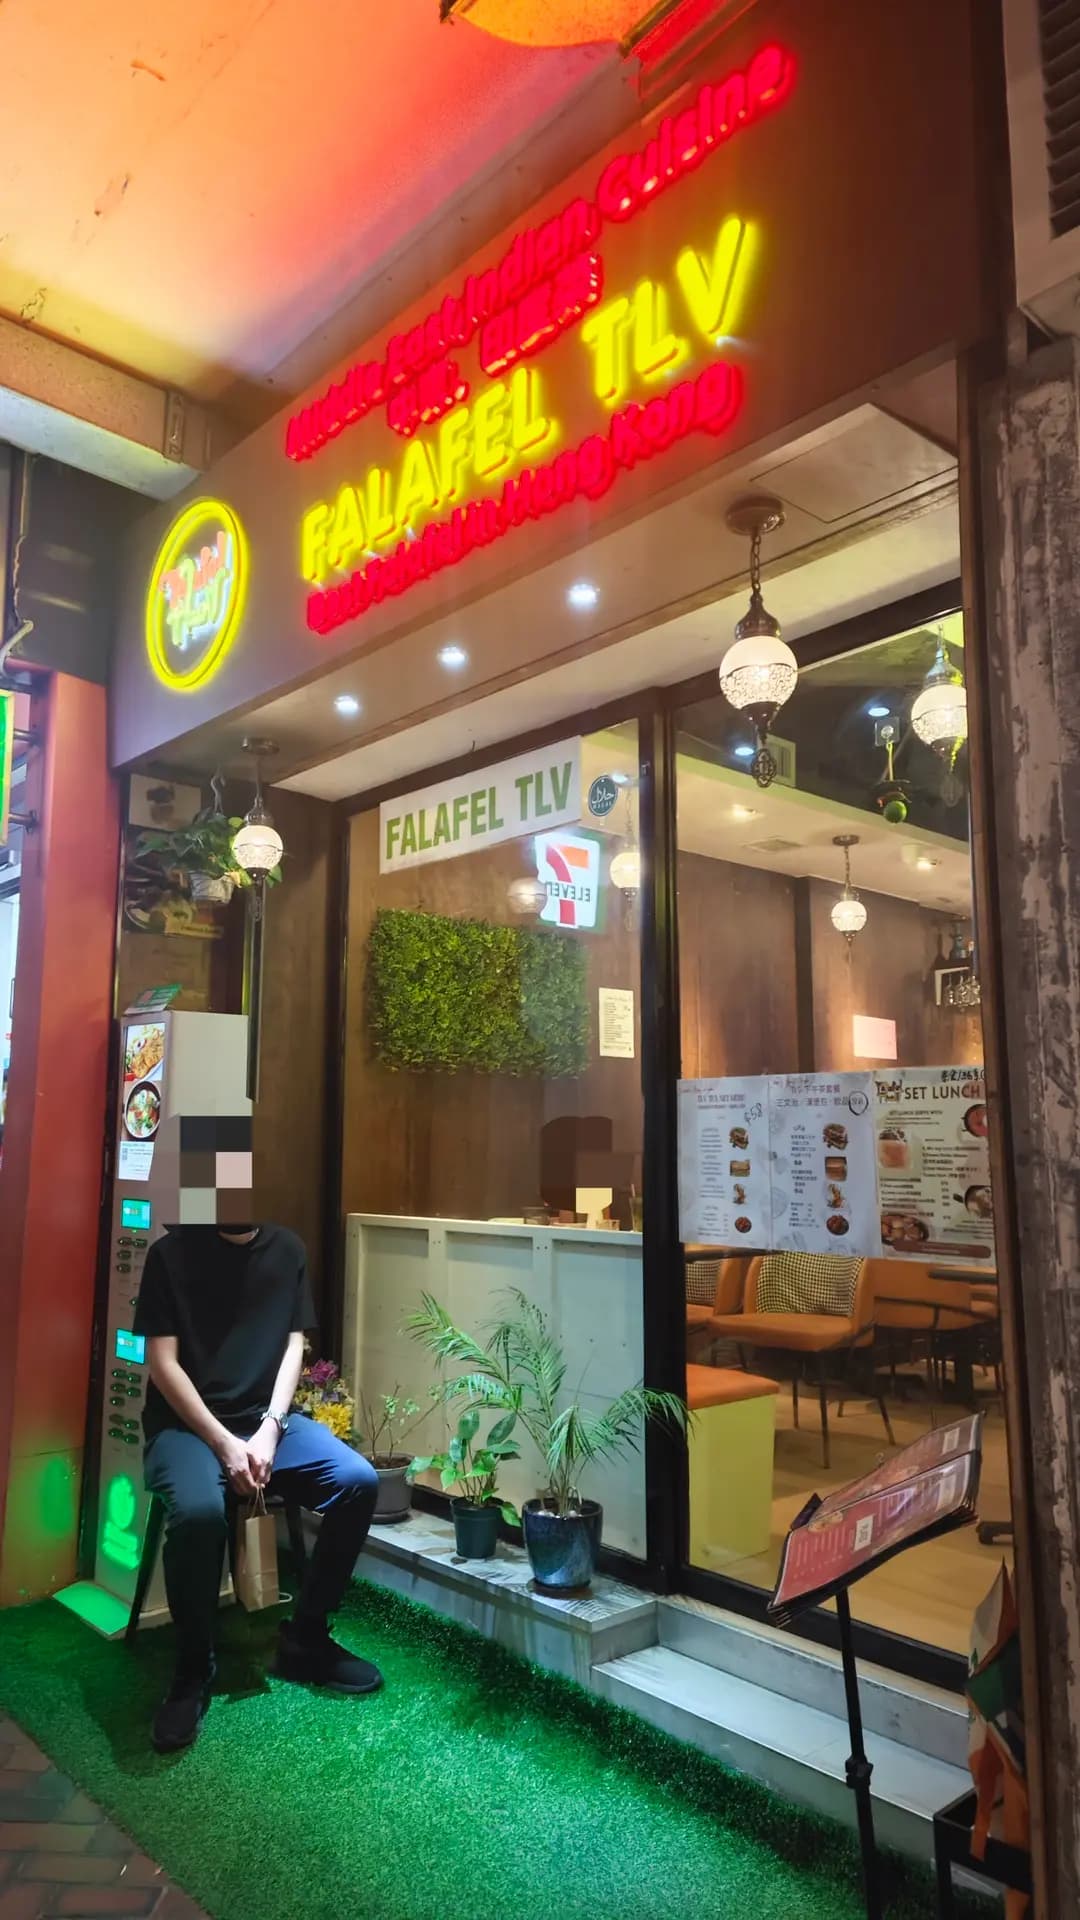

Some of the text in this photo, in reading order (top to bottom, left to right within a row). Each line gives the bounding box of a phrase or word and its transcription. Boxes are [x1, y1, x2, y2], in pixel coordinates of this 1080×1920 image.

[462, 197, 603, 328] Indian
[596, 42, 797, 223] Cuisine
[301, 214, 757, 580] FALAFEL TLV
[502, 434, 616, 527] Hong
[609, 360, 744, 470] Kong
[385, 761, 573, 860] FALAFEL TLV
[904, 1086, 928, 1100] SET
[932, 1084, 980, 1099] LUNCH
